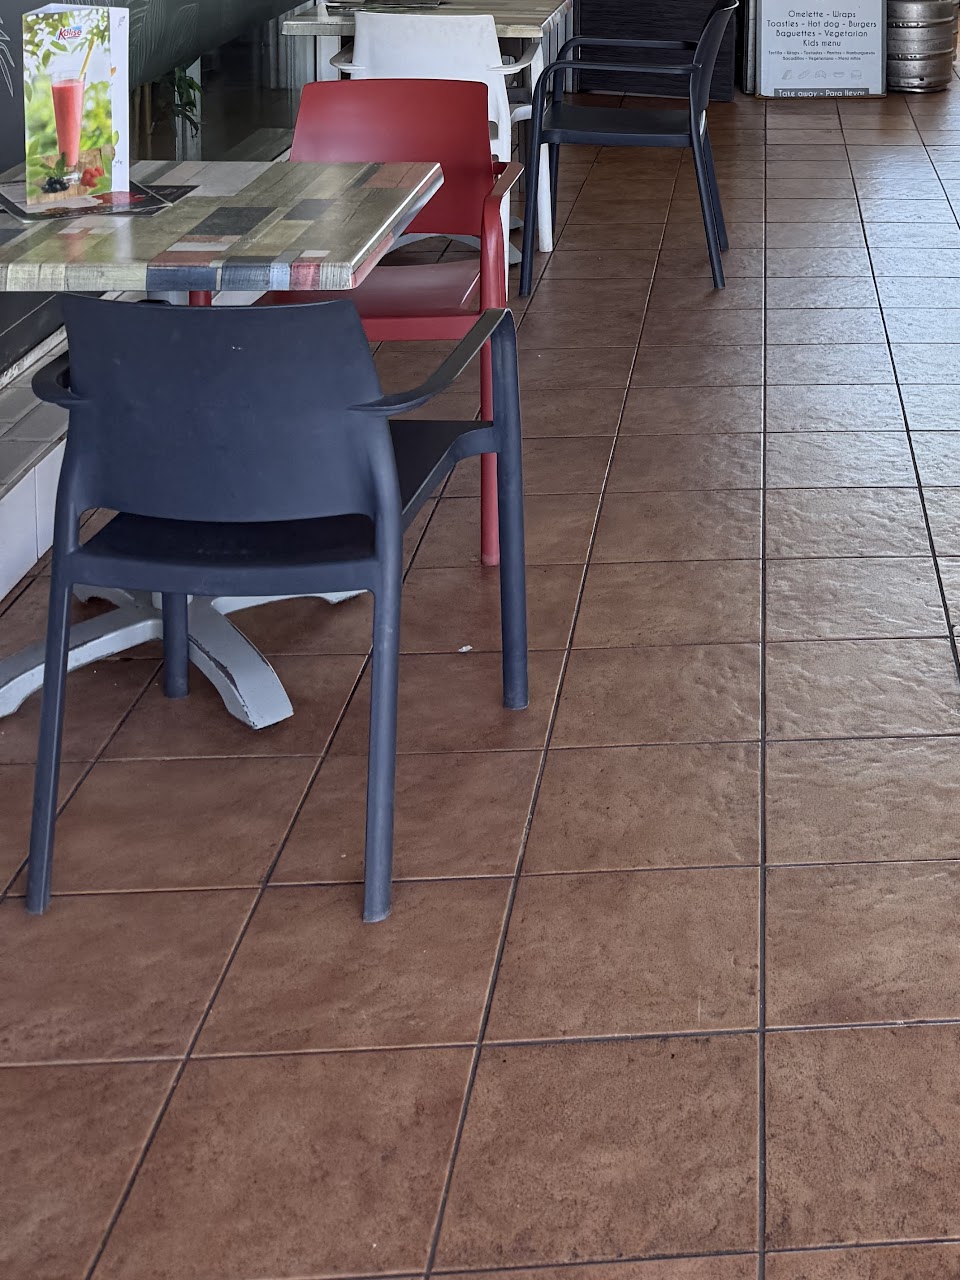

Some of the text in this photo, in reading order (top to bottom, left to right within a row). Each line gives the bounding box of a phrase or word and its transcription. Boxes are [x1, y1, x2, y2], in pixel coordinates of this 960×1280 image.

[788, 9, 856, 19] Omelette Wraps
[767, 20, 877, 29] Toasties Hot dog Burgers
[775, 29, 868, 38] Baguettes Vegetarian
[802, 39, 819, 47] Kids
[778, 89, 796, 97] Take
[825, 89, 843, 97] Para
